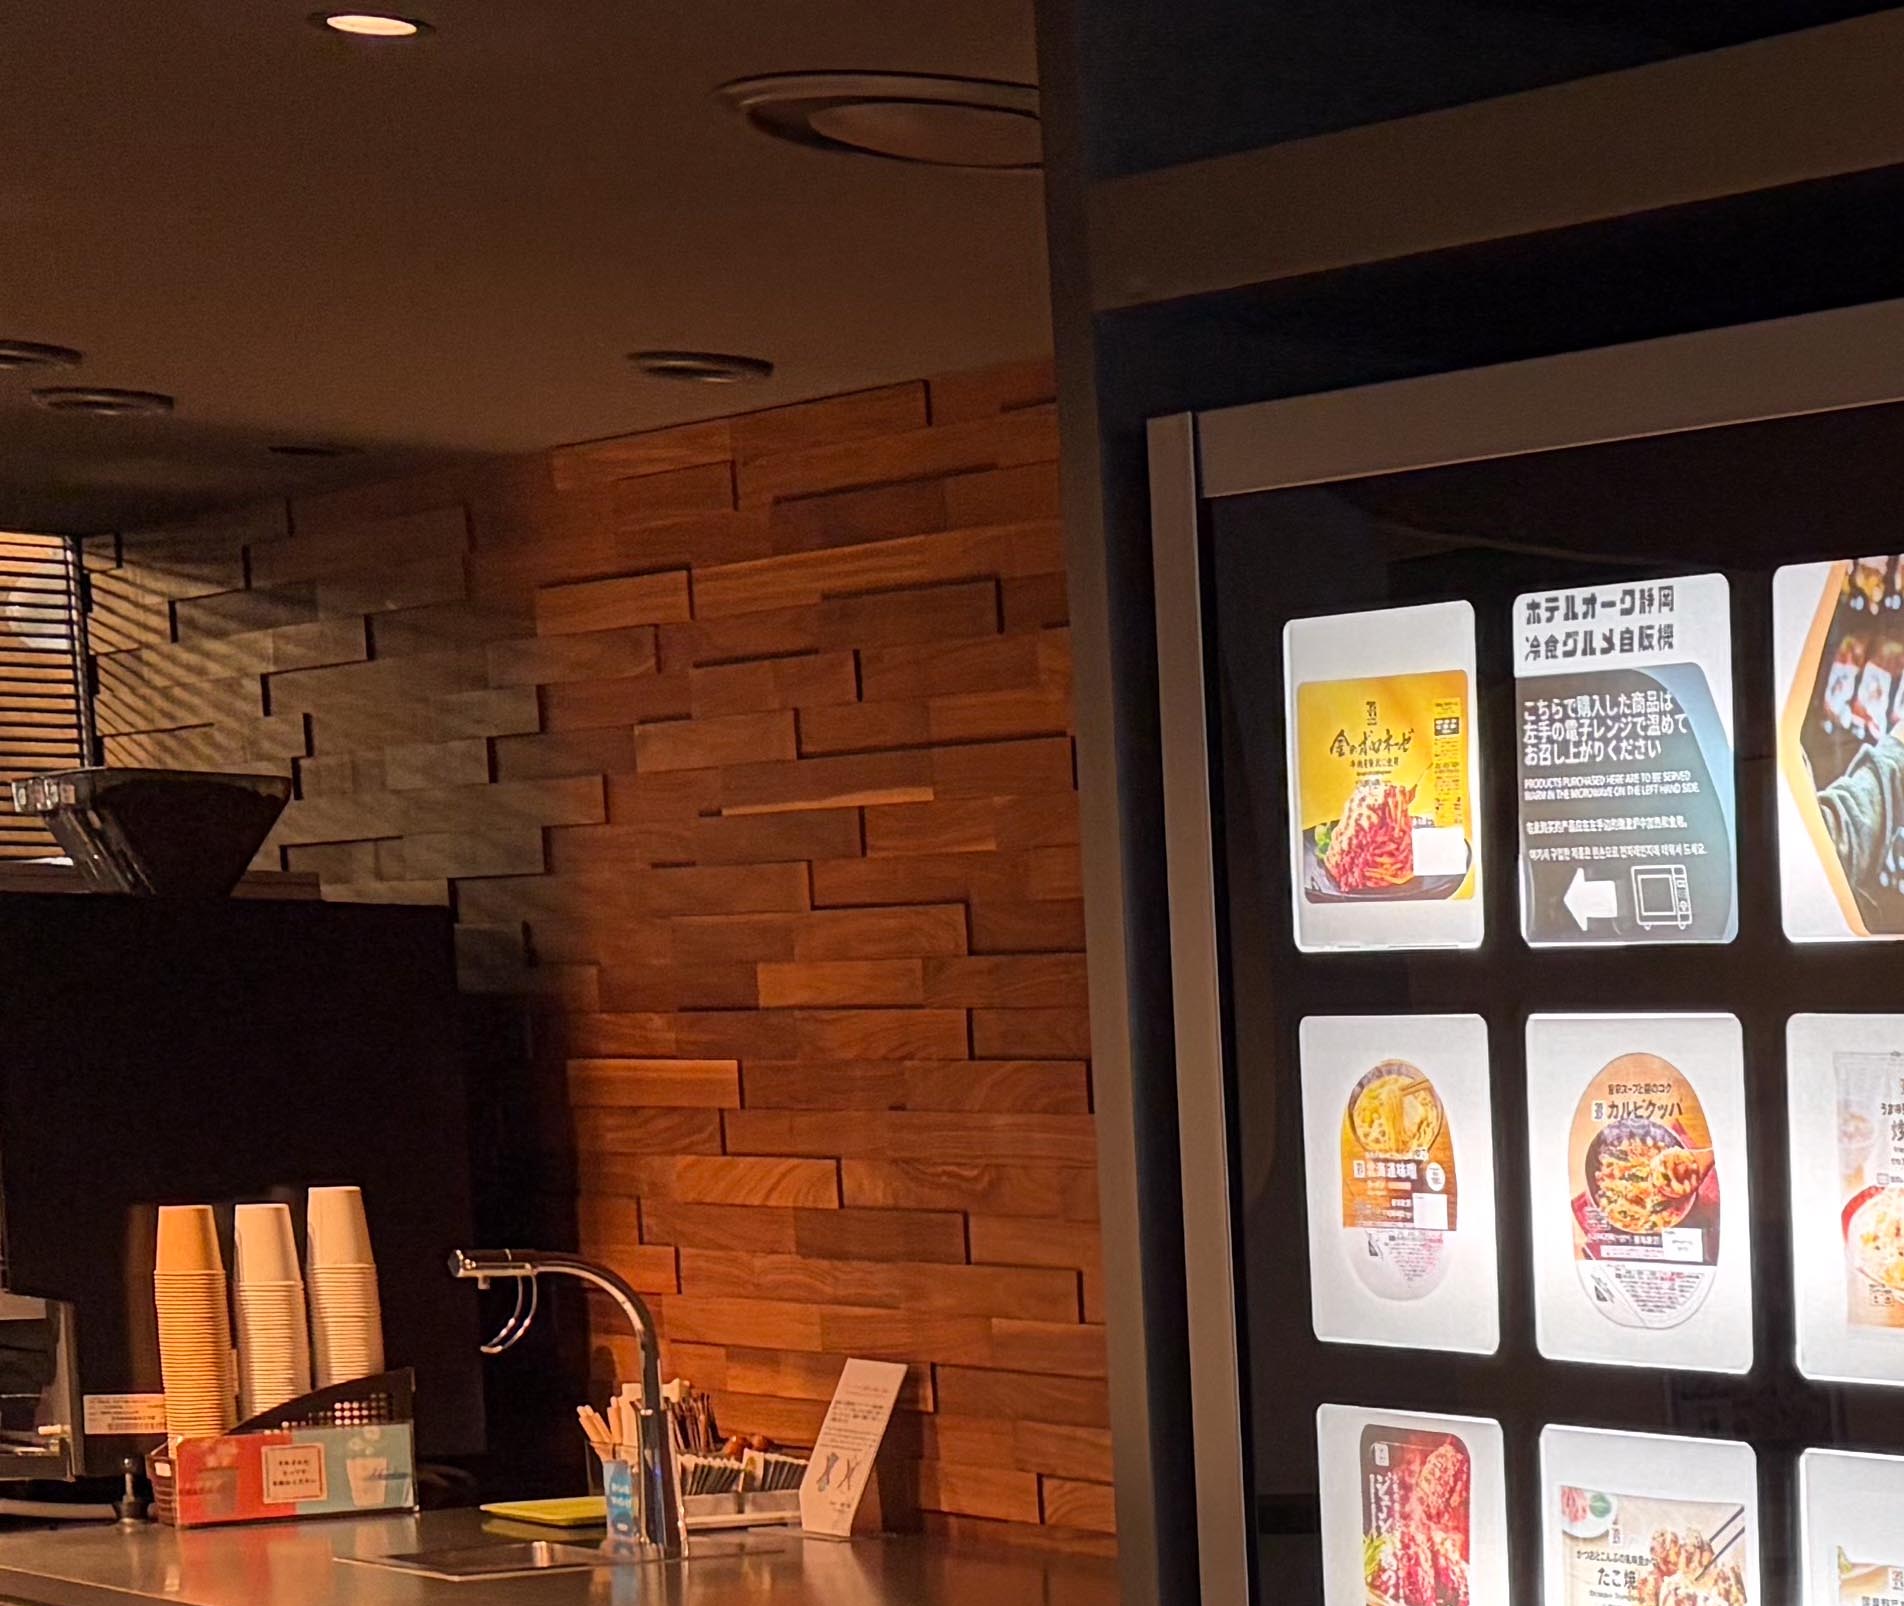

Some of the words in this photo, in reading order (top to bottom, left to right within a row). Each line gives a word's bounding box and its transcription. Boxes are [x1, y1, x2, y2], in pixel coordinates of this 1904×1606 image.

[1525, 585, 1675, 625] ホテルオーク静岡
[1524, 624, 1675, 662] 冷食グルメ自販機
[1524, 691, 1674, 721] こちらで購入した商品は
[1523, 714, 1689, 744] 左手の電子レンジで温めて
[1524, 739, 1662, 766] お召し上がりください
